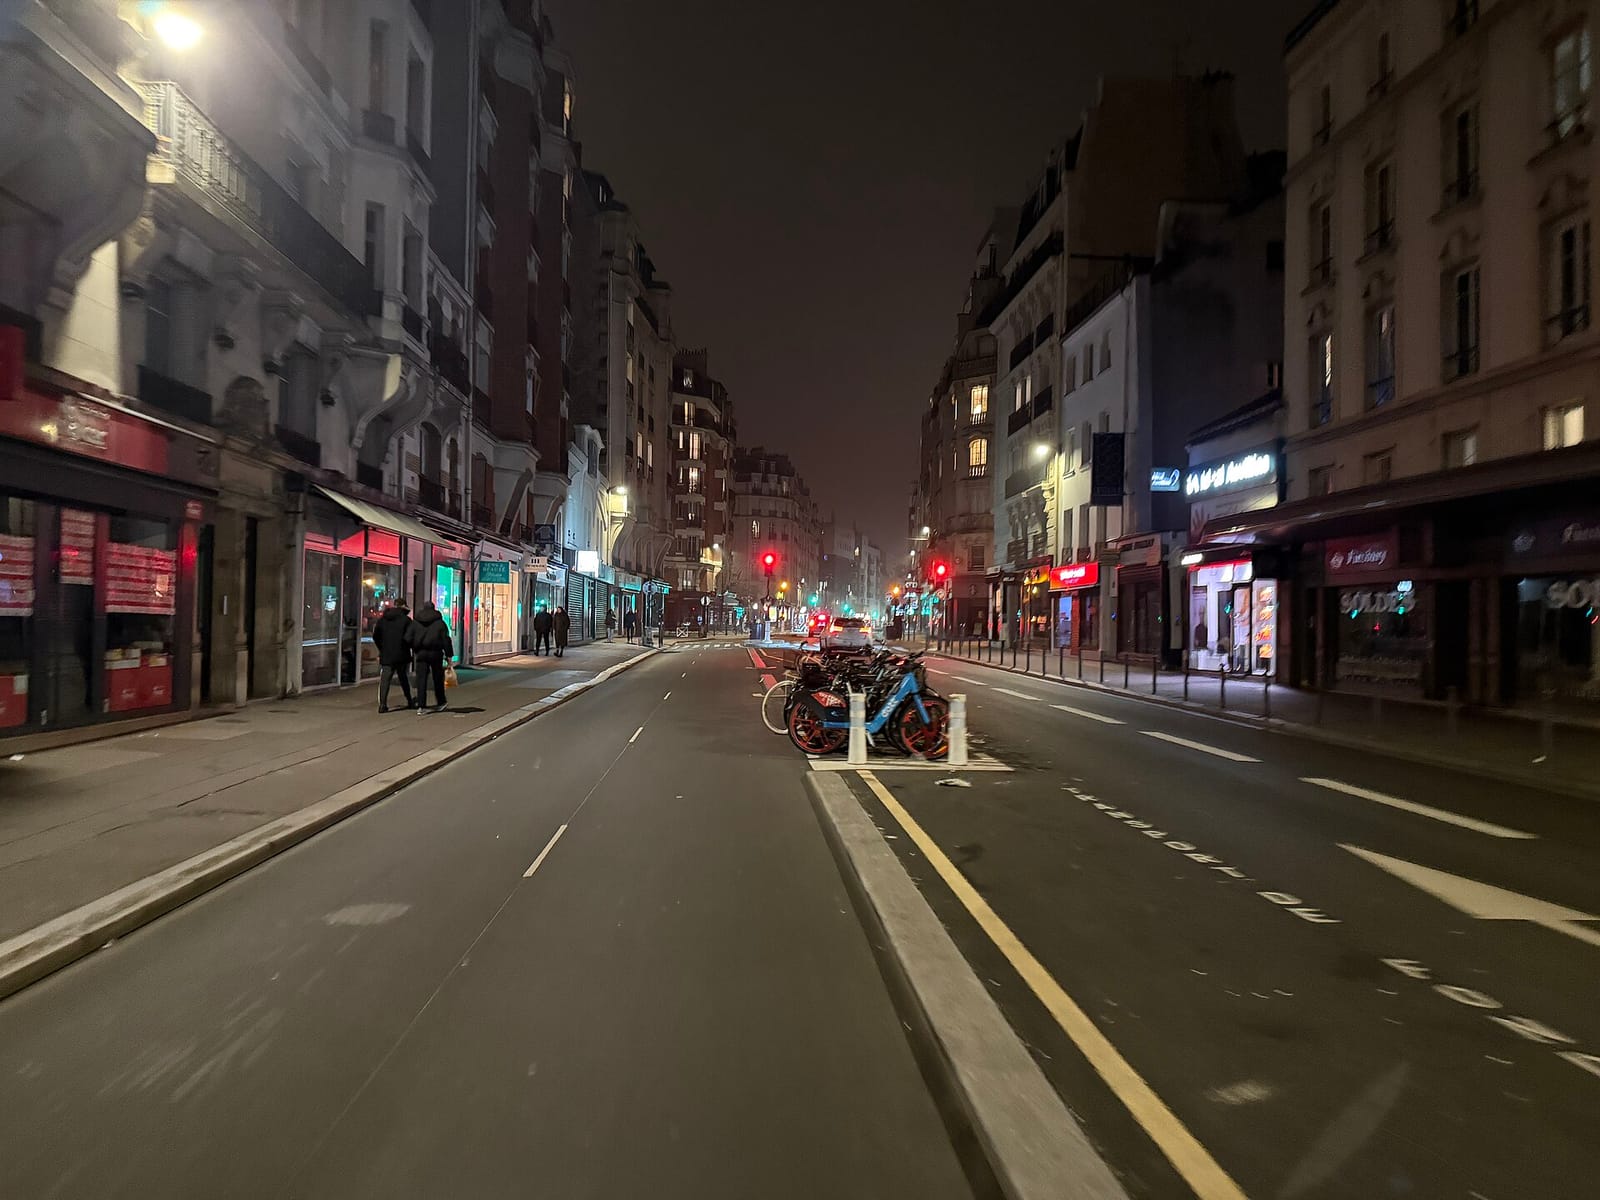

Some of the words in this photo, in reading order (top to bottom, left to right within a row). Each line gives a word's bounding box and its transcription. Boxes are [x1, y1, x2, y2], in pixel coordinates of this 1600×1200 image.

[1340, 589, 1417, 614] SOLDES
[1061, 787, 1247, 878] TRANSPORT
[1256, 891, 1344, 923] DE
